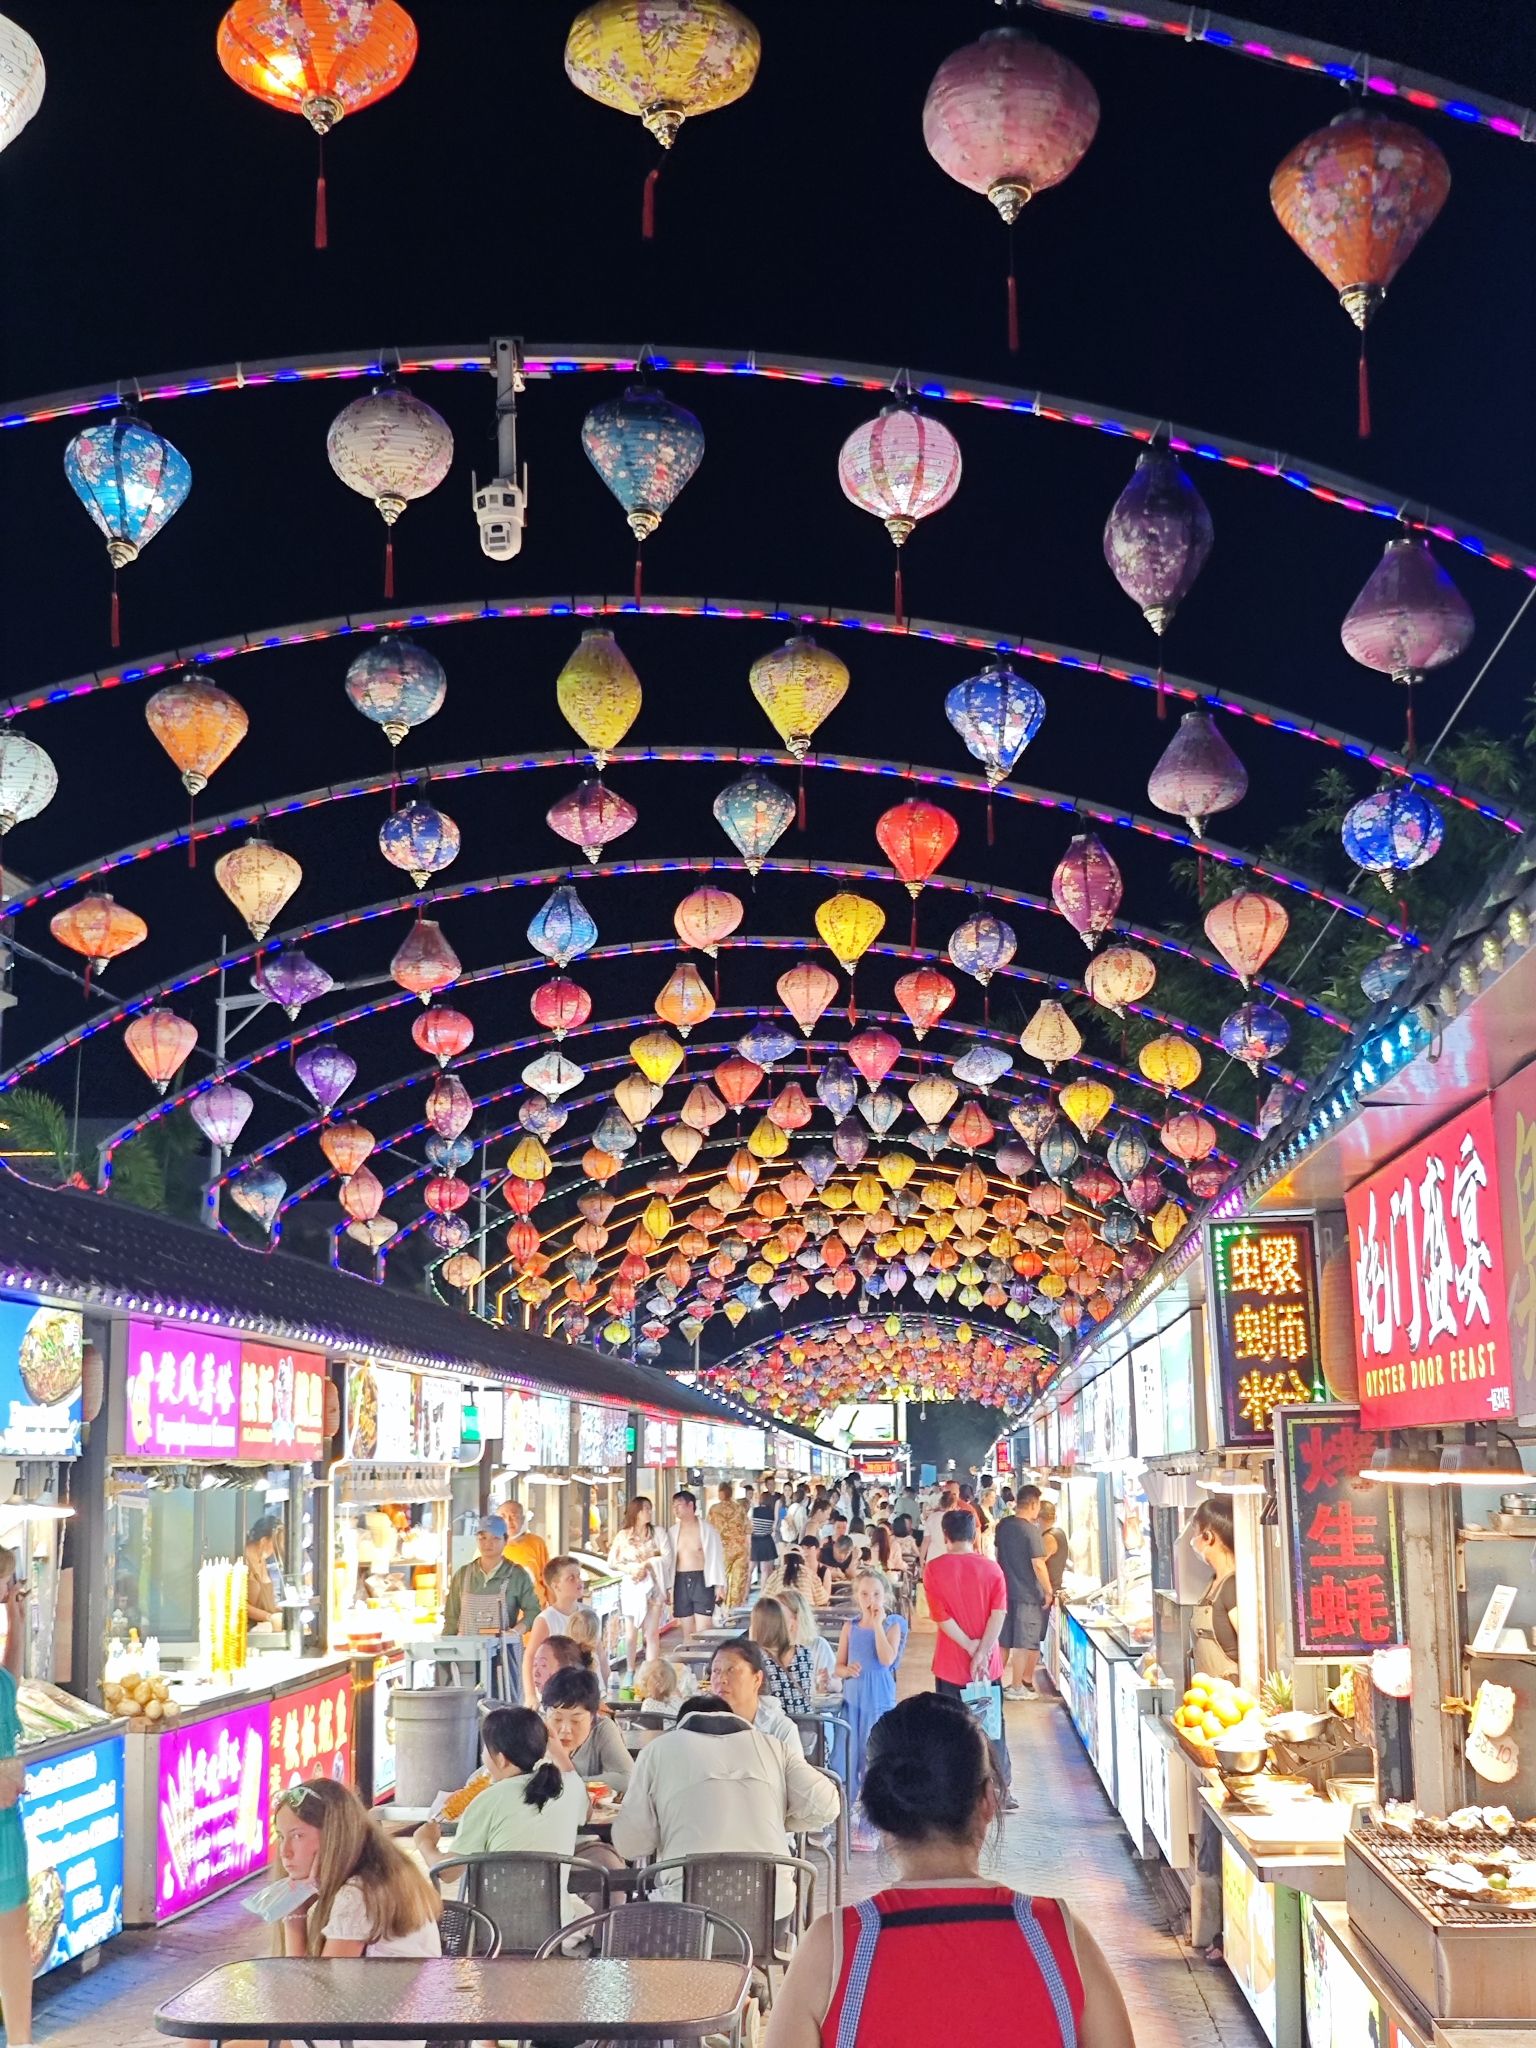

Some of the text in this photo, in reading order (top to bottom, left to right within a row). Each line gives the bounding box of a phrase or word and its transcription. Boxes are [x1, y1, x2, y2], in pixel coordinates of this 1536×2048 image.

[1366, 1341, 1496, 1398] OYSTER DOOR FEAST
[1300, 1426, 1391, 1642] 烤生蚝
